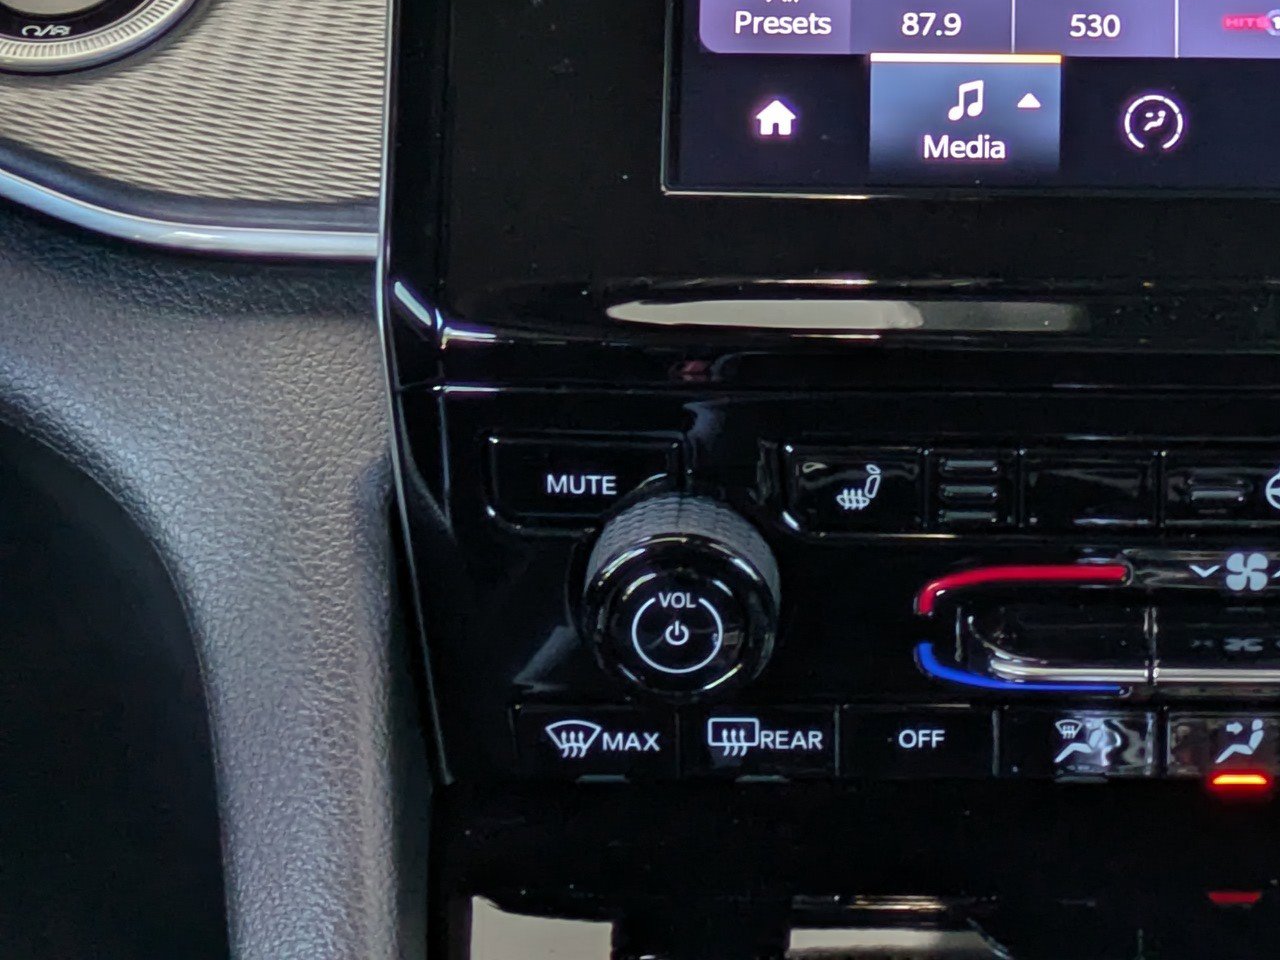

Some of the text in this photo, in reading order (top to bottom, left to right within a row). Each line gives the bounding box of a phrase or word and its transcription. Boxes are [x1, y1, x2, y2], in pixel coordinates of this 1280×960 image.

[735, 10, 832, 36] Presets
[901, 12, 962, 37] 87.9
[1069, 13, 1121, 38] 530
[922, 134, 1006, 160] Media
[546, 474, 618, 496] MUTE
[658, 592, 696, 610] VOL
[602, 732, 660, 752] MAX
[760, 730, 824, 750] REAR
[898, 729, 946, 749] OFF
